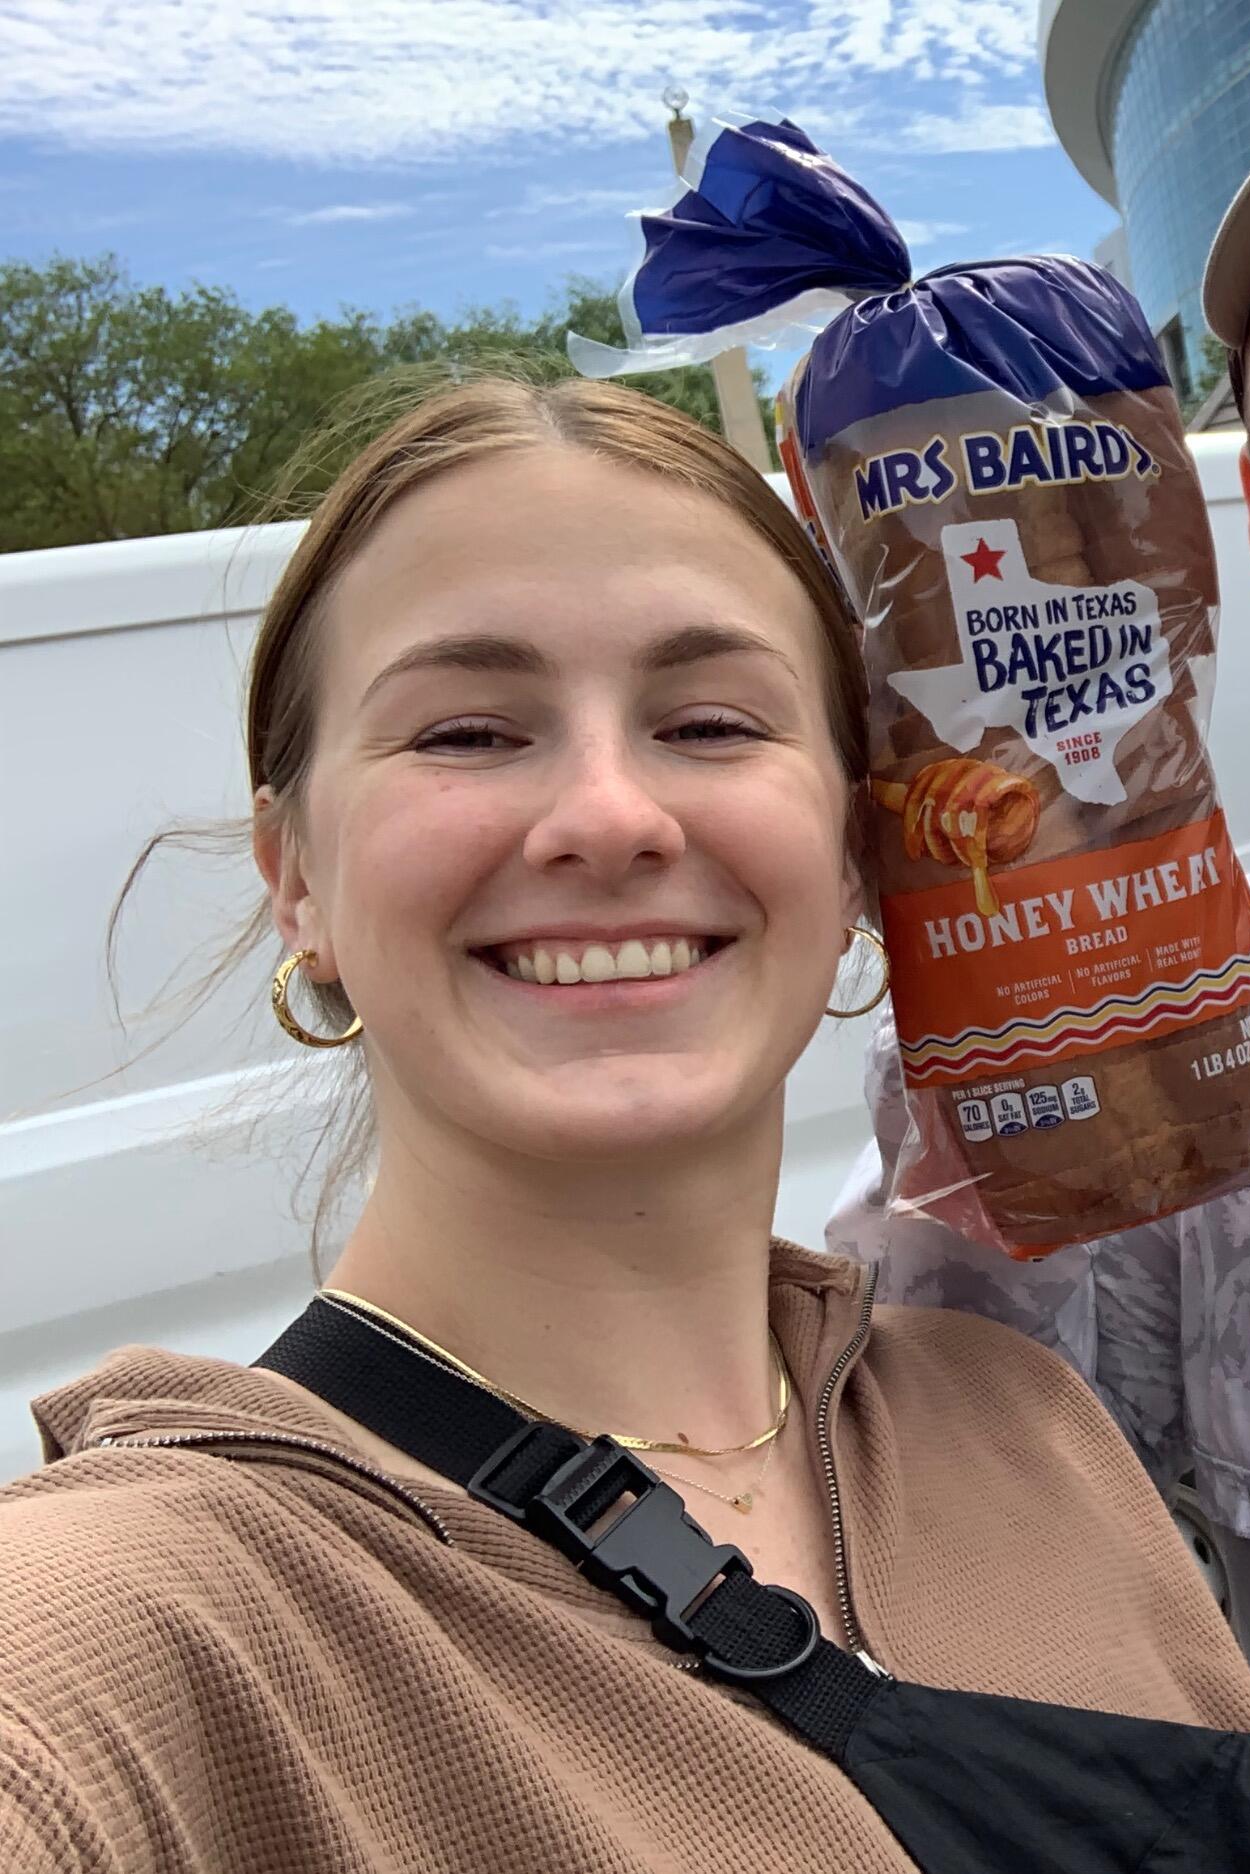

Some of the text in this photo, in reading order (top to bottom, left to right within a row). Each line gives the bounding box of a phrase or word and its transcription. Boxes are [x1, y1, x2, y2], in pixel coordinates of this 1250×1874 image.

[853, 436, 956, 522] MRS
[966, 591, 1137, 636] BORN IN TEXAS
[972, 624, 1152, 693] BAKED IN
[1021, 663, 1156, 739] TEXAS
[1056, 731, 1102, 752] SINCE
[1064, 747, 1100, 766] 1908
[925, 847, 1222, 959] HONEY WHEAT
[1065, 926, 1128, 955] BREAD
[1093, 954, 1142, 975] ARTIFICIAL
[1156, 954, 1179, 969] REAL
[1014, 974, 1063, 993] ARTIFICIAL
[1091, 969, 1132, 987] FLAVORS
[1014, 989, 1050, 1006] COLORS
[1191, 1059, 1202, 1081] 1
[1203, 1053, 1224, 1077] LB
[1225, 1048, 1236, 1069] 4
[963, 1104, 981, 1122] 70
[1010, 1111, 1021, 1120] FAT
